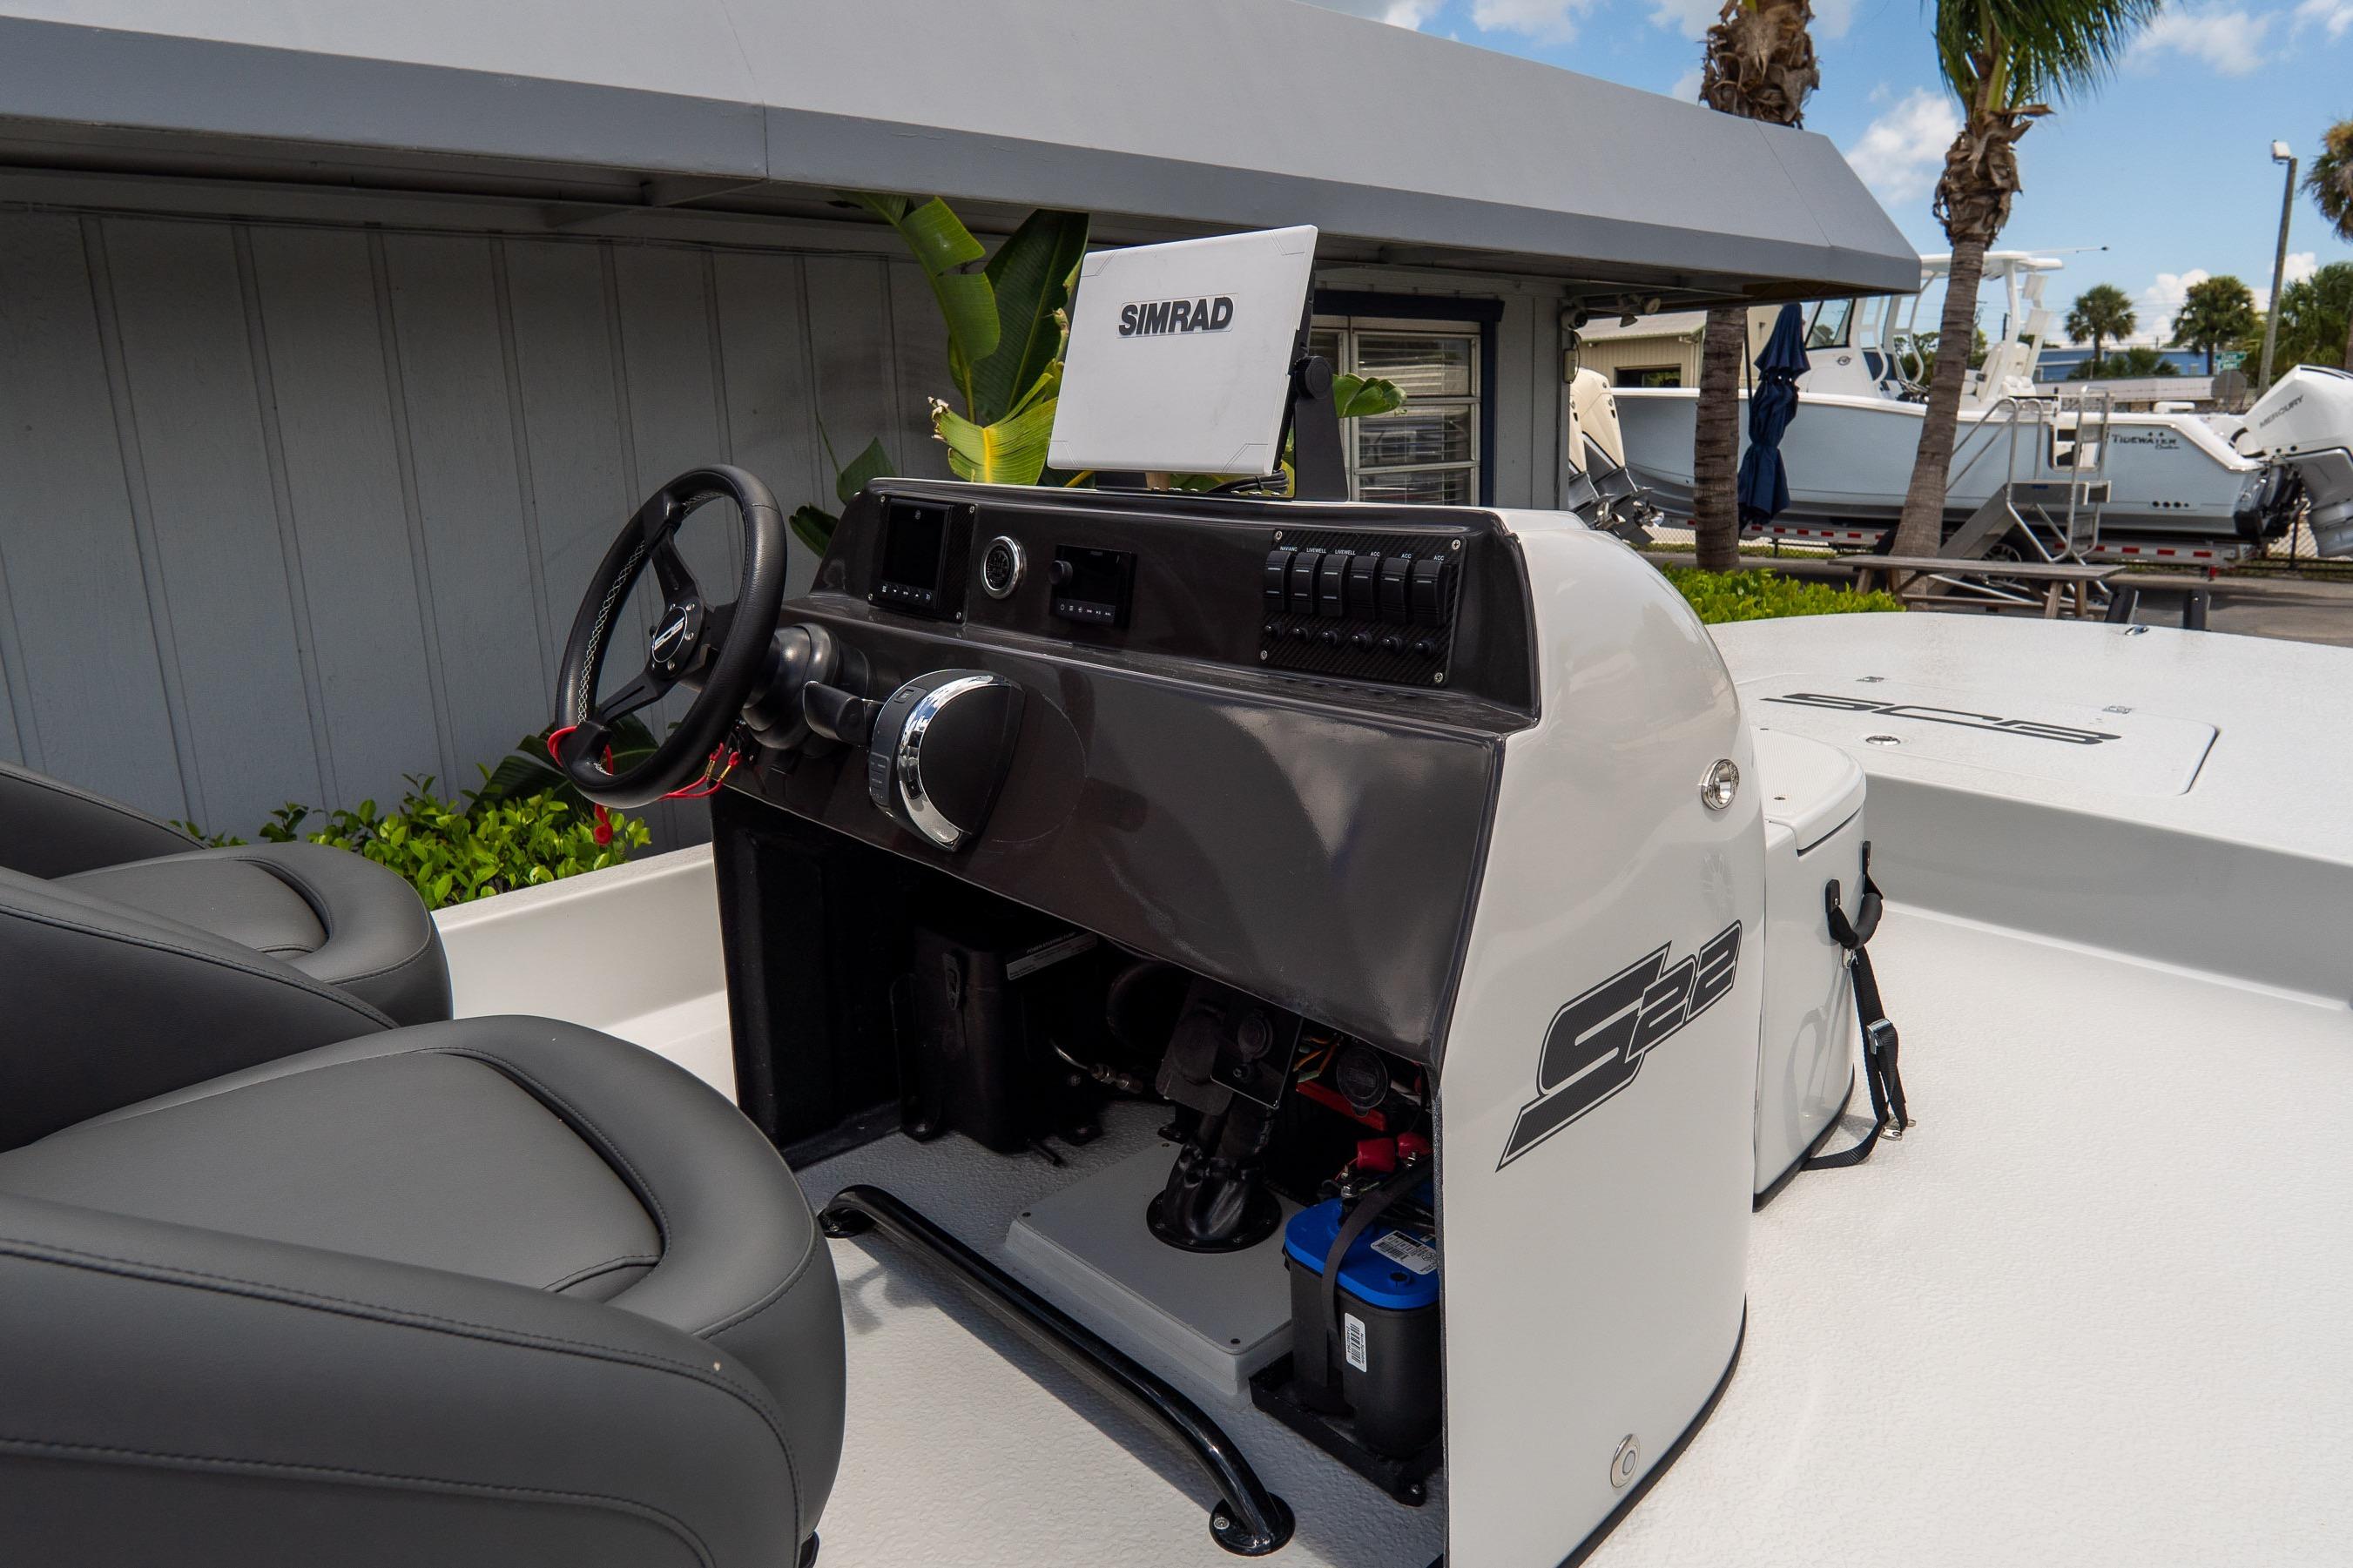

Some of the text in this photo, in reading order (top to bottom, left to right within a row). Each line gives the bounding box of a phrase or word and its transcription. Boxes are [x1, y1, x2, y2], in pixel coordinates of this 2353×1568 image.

[1118, 296, 1234, 336] SIMRAD
[1759, 693, 2121, 745] SCB
[1495, 919, 1742, 1173] S22
